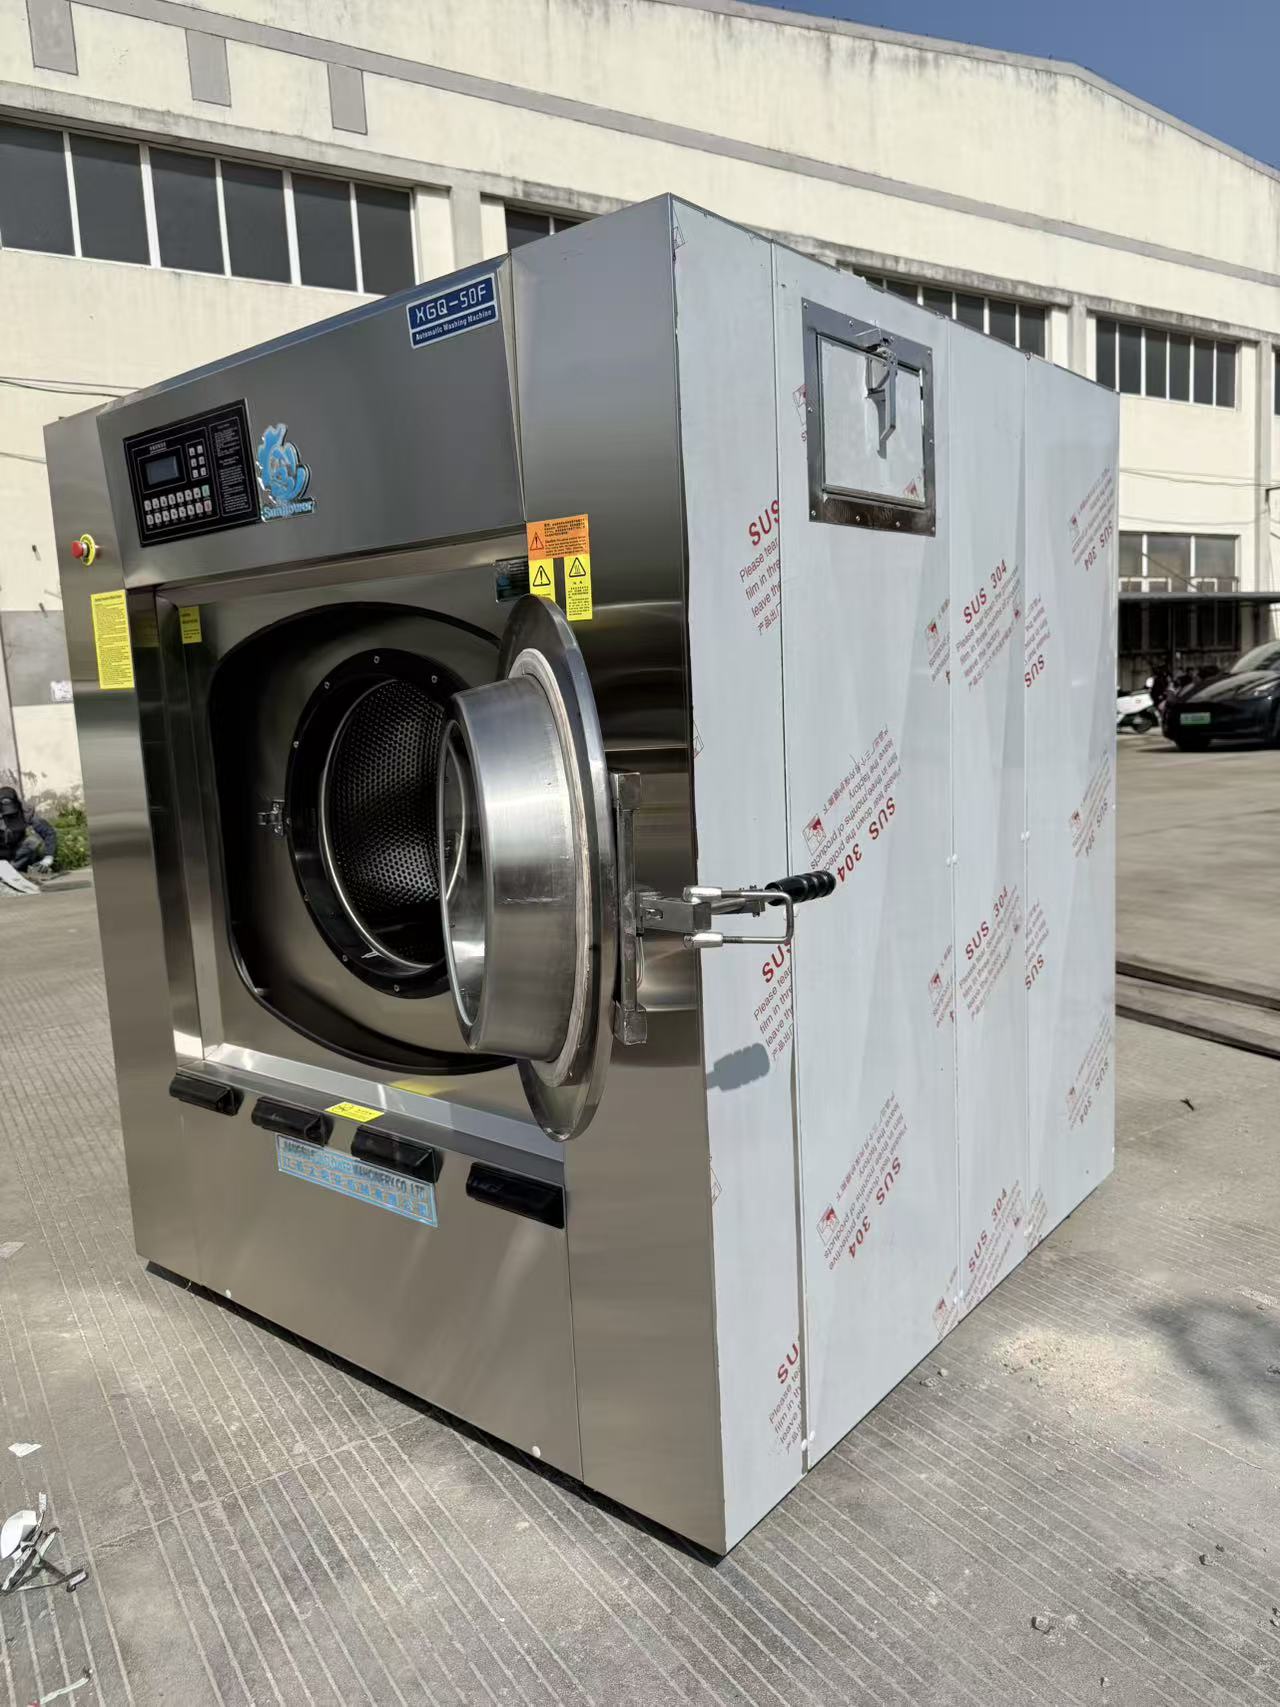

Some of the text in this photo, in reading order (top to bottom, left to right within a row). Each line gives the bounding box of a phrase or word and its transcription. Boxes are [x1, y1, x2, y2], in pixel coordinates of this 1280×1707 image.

[416, 284, 487, 324] XGQ-50F
[415, 309, 492, 341] Automatic Washing Machine
[739, 537, 778, 583] Please tear
[745, 583, 760, 601] film
[759, 573, 767, 586] in
[963, 559, 1007, 624] SUS 304
[751, 597, 771, 618] leave
[1024, 654, 1045, 688] SUS
[849, 770, 871, 801] factory
[866, 773, 883, 797] three
[872, 791, 885, 809] tear
[844, 792, 868, 826] months
[856, 807, 874, 831] down
[837, 822, 846, 838] of
[837, 797, 896, 882] SUS 304
[845, 827, 857, 845] the
[810, 834, 838, 870] products
[965, 885, 1008, 960] SUS 304
[1025, 954, 1045, 990] SUS
[753, 986, 777, 1021] Please
[759, 1014, 773, 1034] film
[772, 1002, 781, 1016] in
[765, 1019, 785, 1048] leave
[848, 1156, 901, 1259] SUS 304
[968, 1230, 988, 1273] SUS
[768, 1384, 792, 1425] Please
[774, 1412, 788, 1434] film
[787, 1399, 795, 1413] in
[779, 1411, 799, 1445] leave
